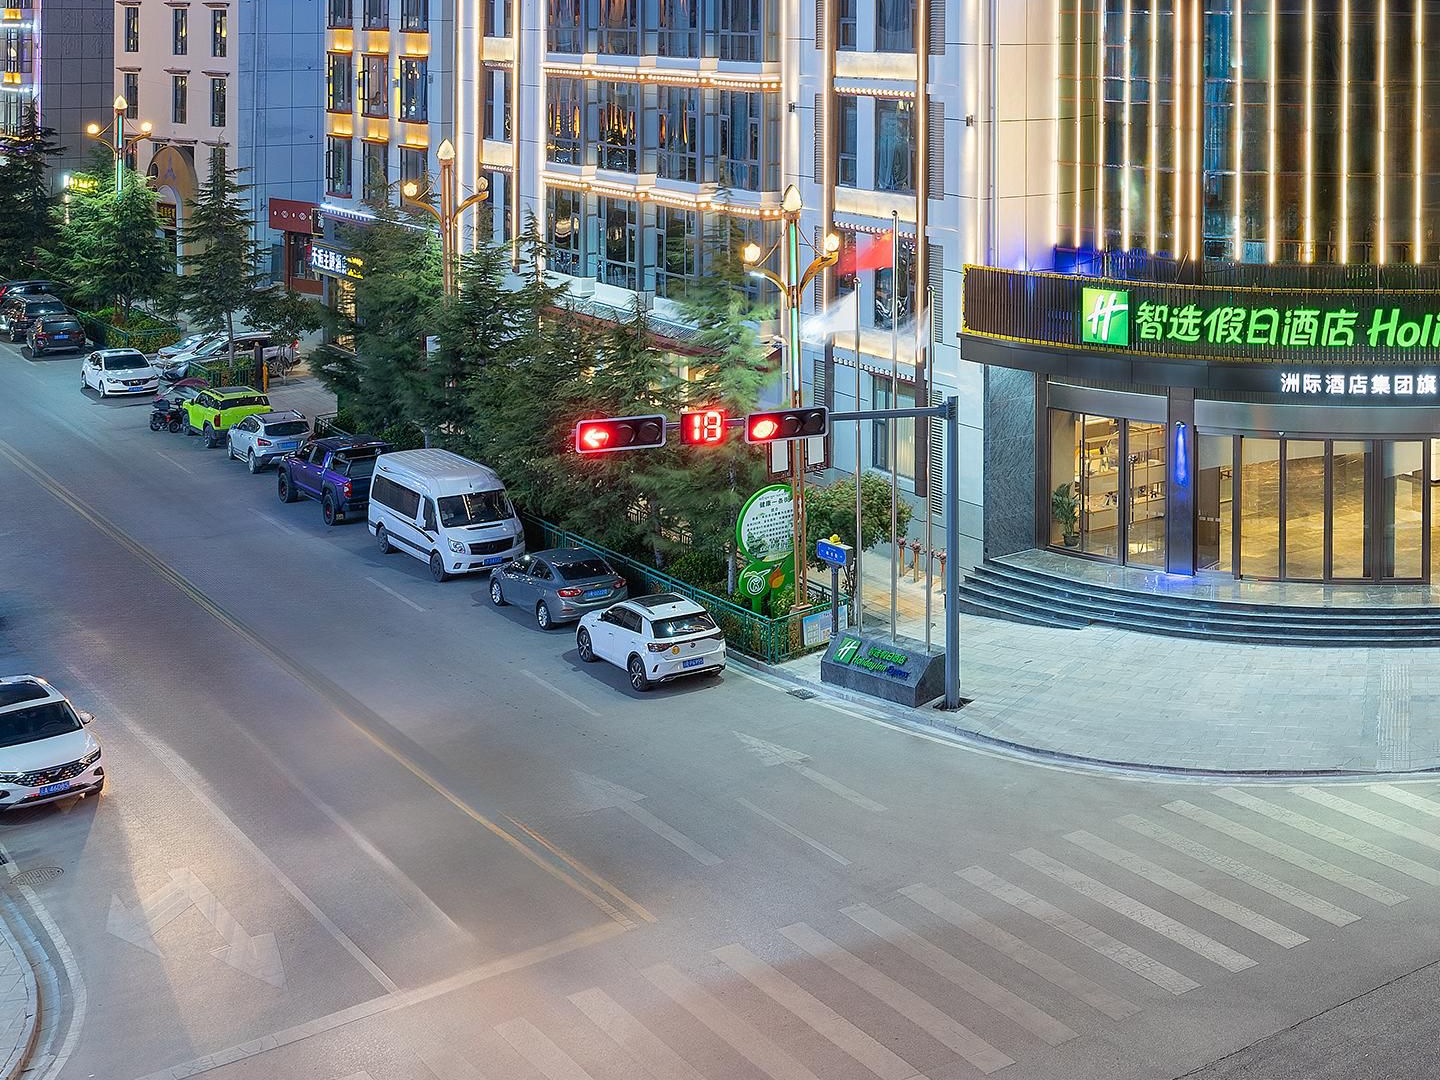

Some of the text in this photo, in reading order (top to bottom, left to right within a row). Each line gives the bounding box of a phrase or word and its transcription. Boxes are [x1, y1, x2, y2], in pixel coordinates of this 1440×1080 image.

[1136, 301, 1359, 348] 智选假日酒店
